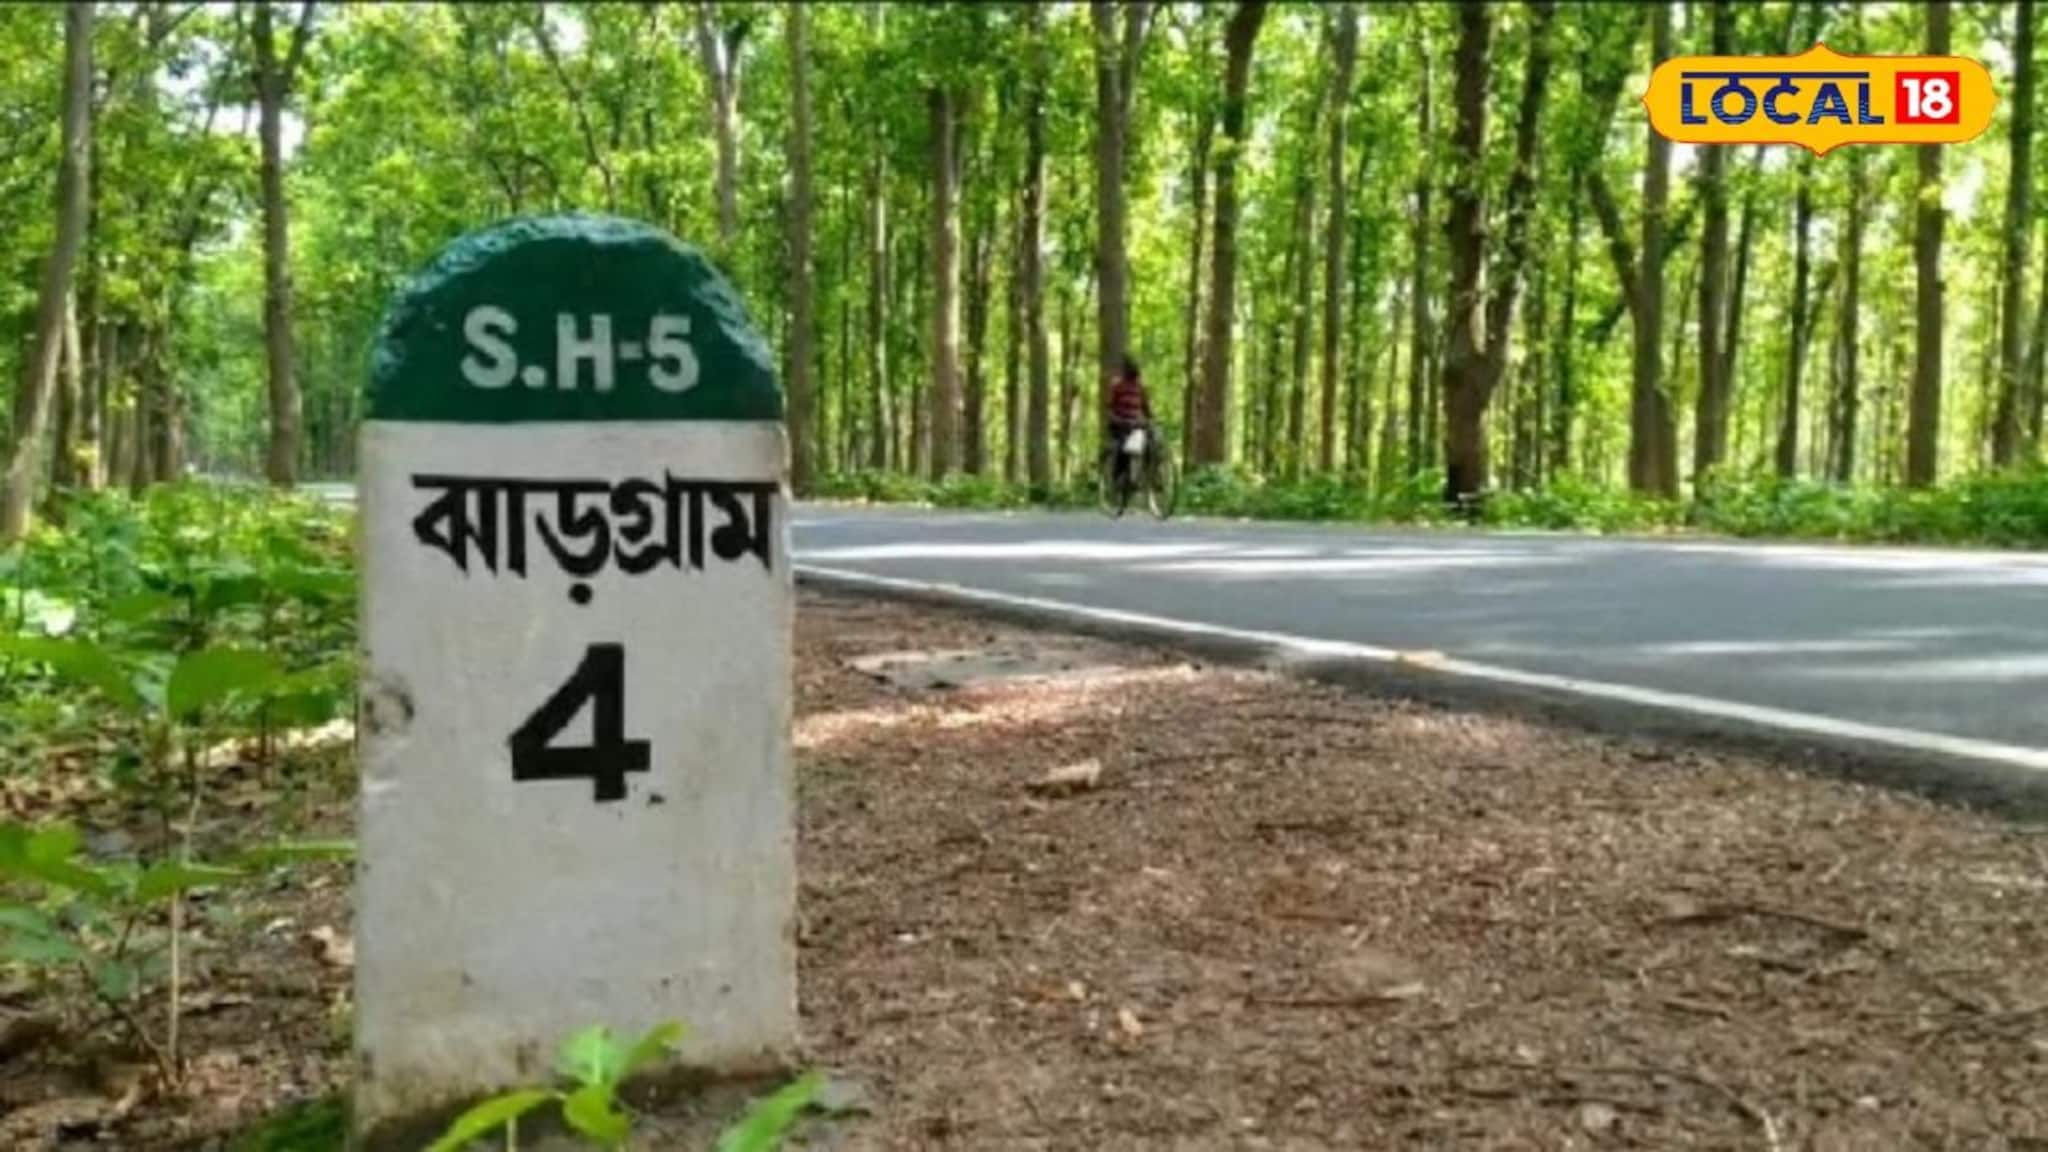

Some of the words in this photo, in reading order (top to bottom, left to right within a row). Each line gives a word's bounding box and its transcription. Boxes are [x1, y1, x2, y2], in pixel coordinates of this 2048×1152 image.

[460, 305, 700, 392] S.H-5
[411, 469, 780, 605] ঝাড়গ্রাম
[507, 642, 652, 803] 4
